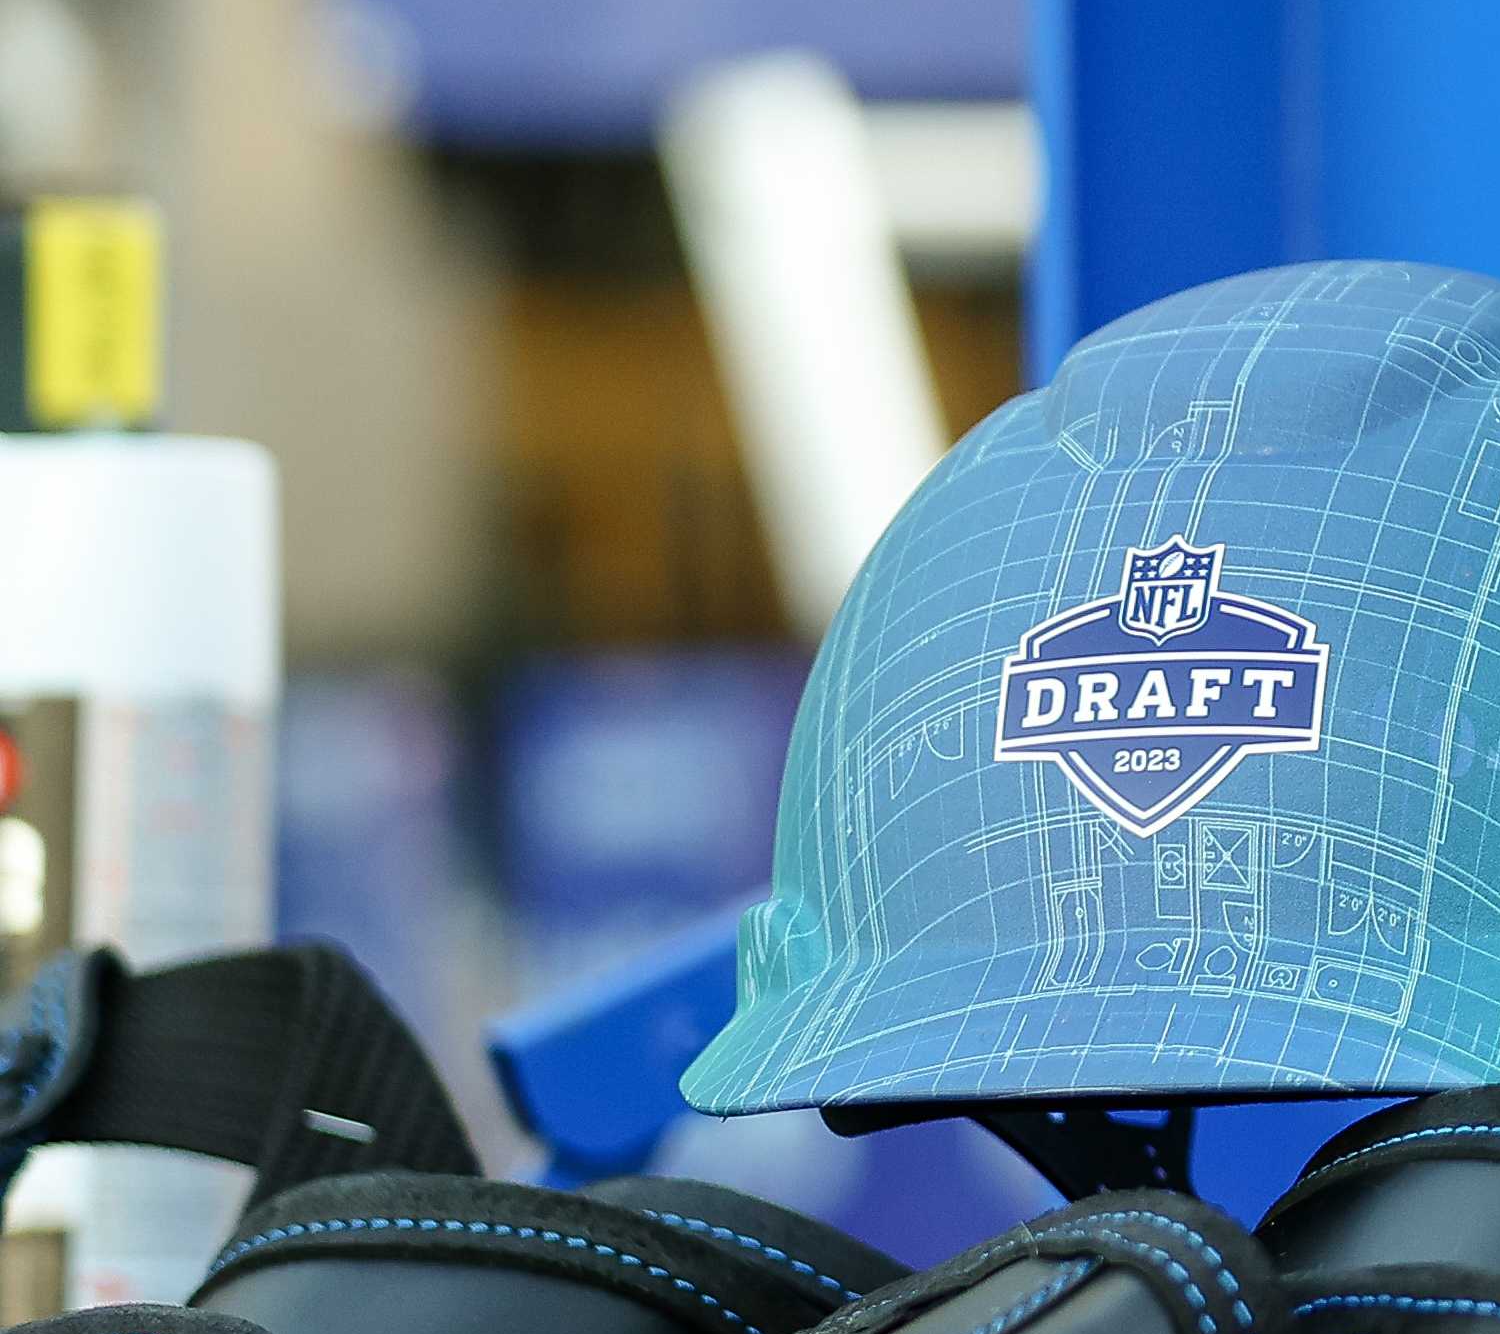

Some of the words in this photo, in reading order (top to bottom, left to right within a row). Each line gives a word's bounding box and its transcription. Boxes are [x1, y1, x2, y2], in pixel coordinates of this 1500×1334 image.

[1129, 584, 1199, 630] NFL
[1021, 668, 1296, 729] DRAFT
[1112, 748, 1183, 773] 2023
